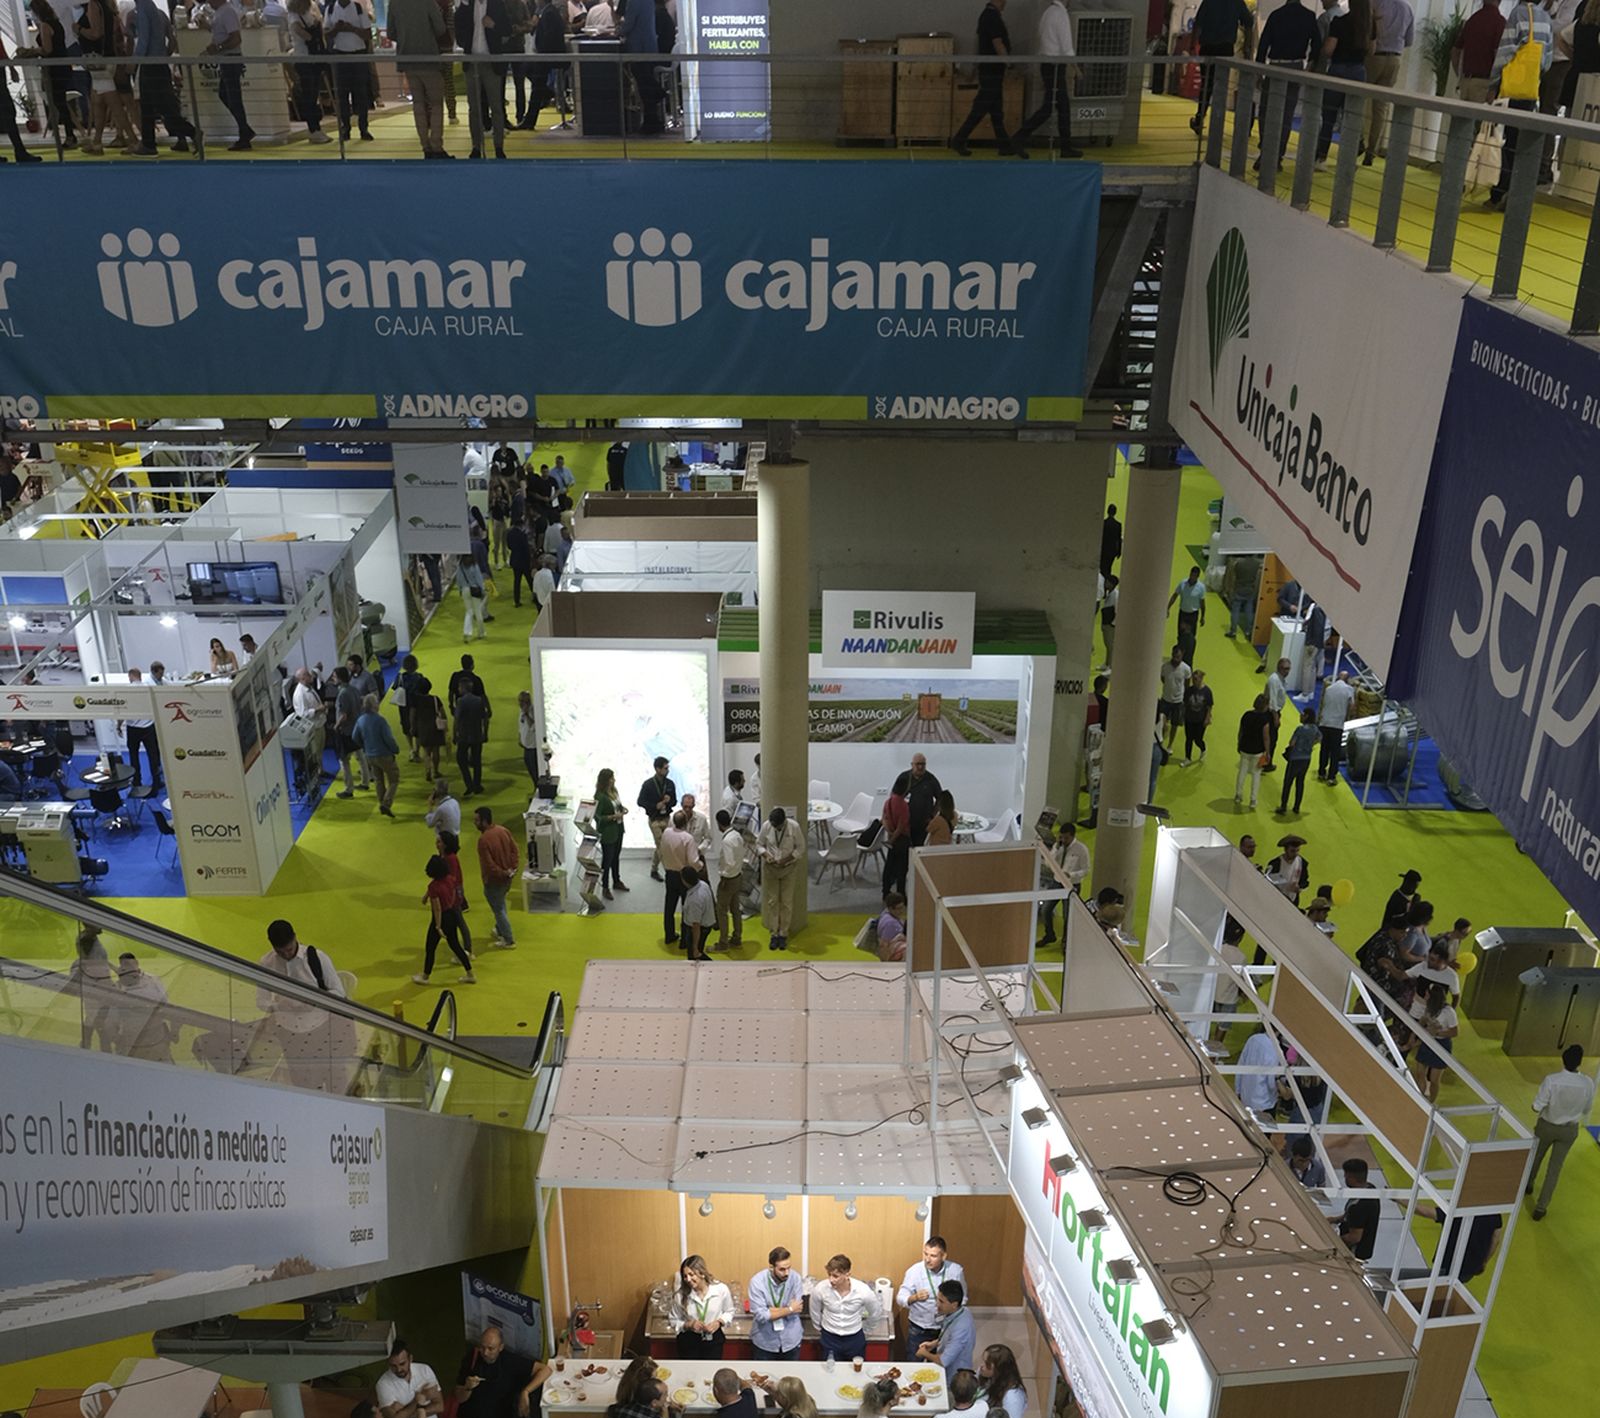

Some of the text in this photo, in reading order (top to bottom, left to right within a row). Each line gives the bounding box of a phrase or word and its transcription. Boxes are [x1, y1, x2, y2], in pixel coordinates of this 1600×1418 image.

[701, 15, 766, 25] SI DISTRIBUYES
[702, 28, 766, 38] FERTILIZANTES,
[709, 40, 759, 49] HABLA CON
[217, 237, 526, 331] cajamar
[725, 238, 1037, 332] cajamar
[375, 316, 523, 336] CAJA RURAL
[877, 317, 1024, 339] CAJA RURAL
[1471, 340, 1570, 410] BIOINSECTICIDAS
[399, 394, 528, 418] ADNAGRO
[889, 396, 1020, 420] ADNAGRO
[1237, 355, 1372, 546] Unicaja Banco
[874, 610, 944, 630] Rivulis
[841, 637, 958, 654] NAANDANJAIN
[822, 709, 835, 719] DE
[837, 707, 901, 719] INNOVACIÓN
[816, 723, 855, 734] CAMPO
[191, 824, 241, 838] ACOM
[23, 1115, 53, 1155] en
[60, 1101, 78, 1156] la
[84, 1103, 200, 1160] financiación
[204, 1128, 213, 1161] a
[217, 1120, 268, 1163] medida
[271, 1124, 287, 1163] de
[330, 1123, 373, 1174] cajasur
[15, 1180, 28, 1234] y
[37, 1166, 167, 1219] reconversión
[170, 1166, 190, 1212] de
[194, 1166, 236, 1211] fincas
[240, 1168, 287, 1209] rústicas
